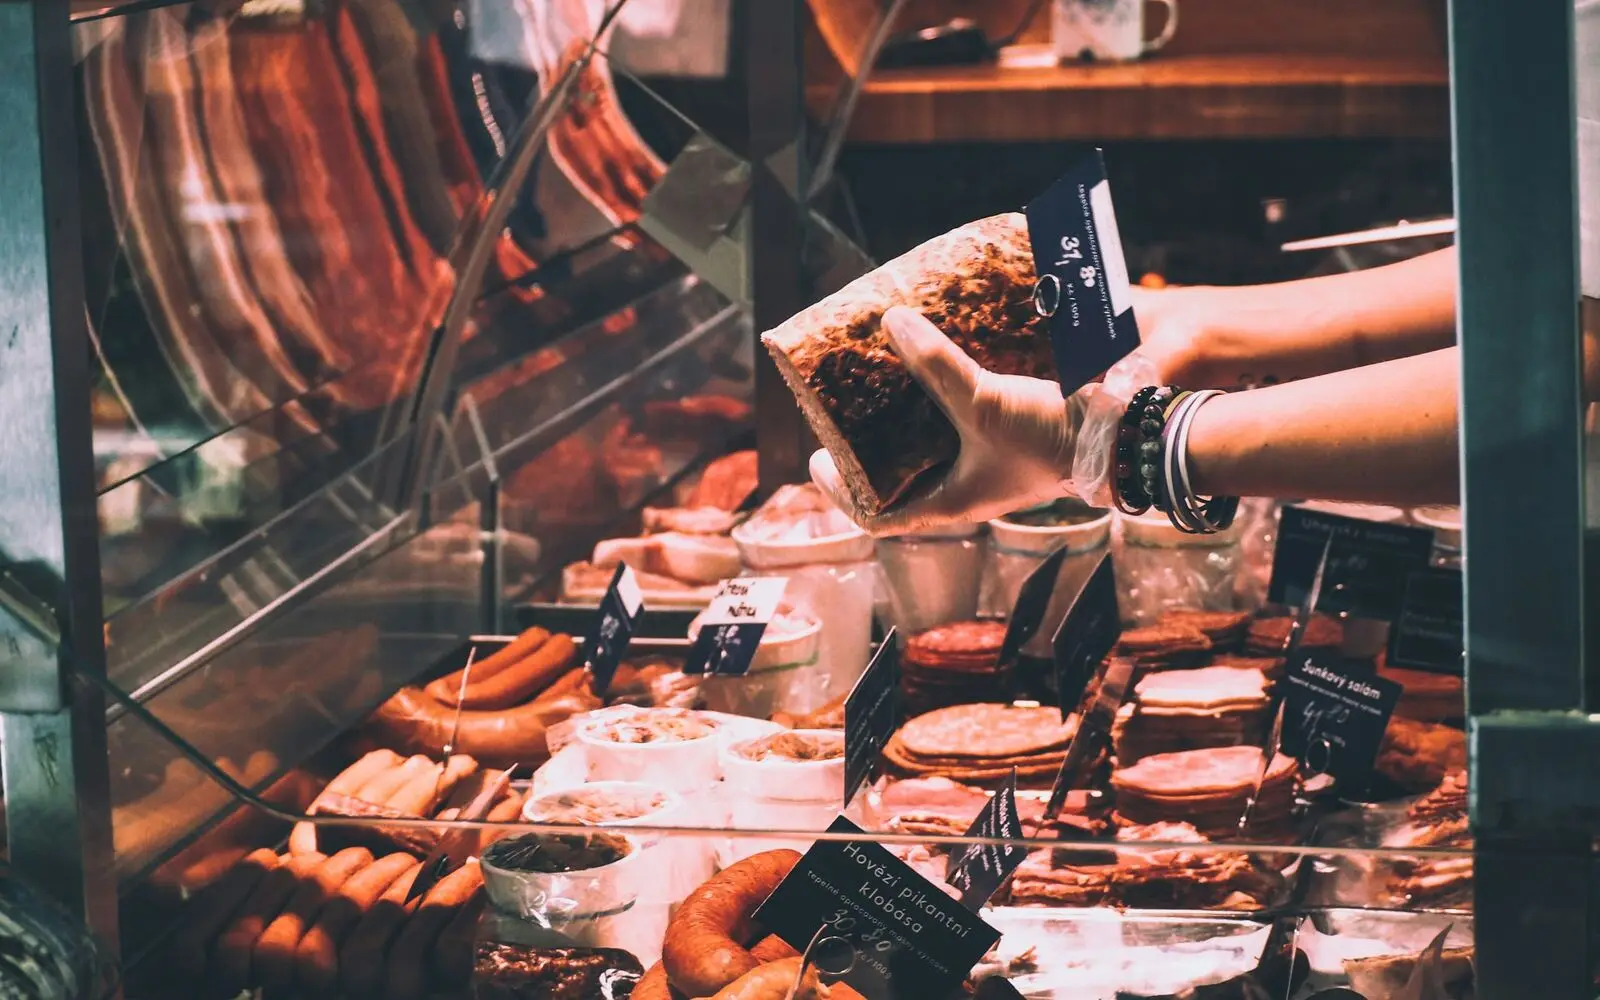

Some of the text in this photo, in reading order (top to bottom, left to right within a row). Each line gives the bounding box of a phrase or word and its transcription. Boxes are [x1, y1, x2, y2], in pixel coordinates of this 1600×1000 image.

[1301, 658, 1381, 699] Šunkový salám
[807, 869, 839, 896] tepelně
[839, 893, 888, 931] opracovaný
[843, 841, 972, 938] Hovězí pikantní
[858, 881, 923, 933] klobása
